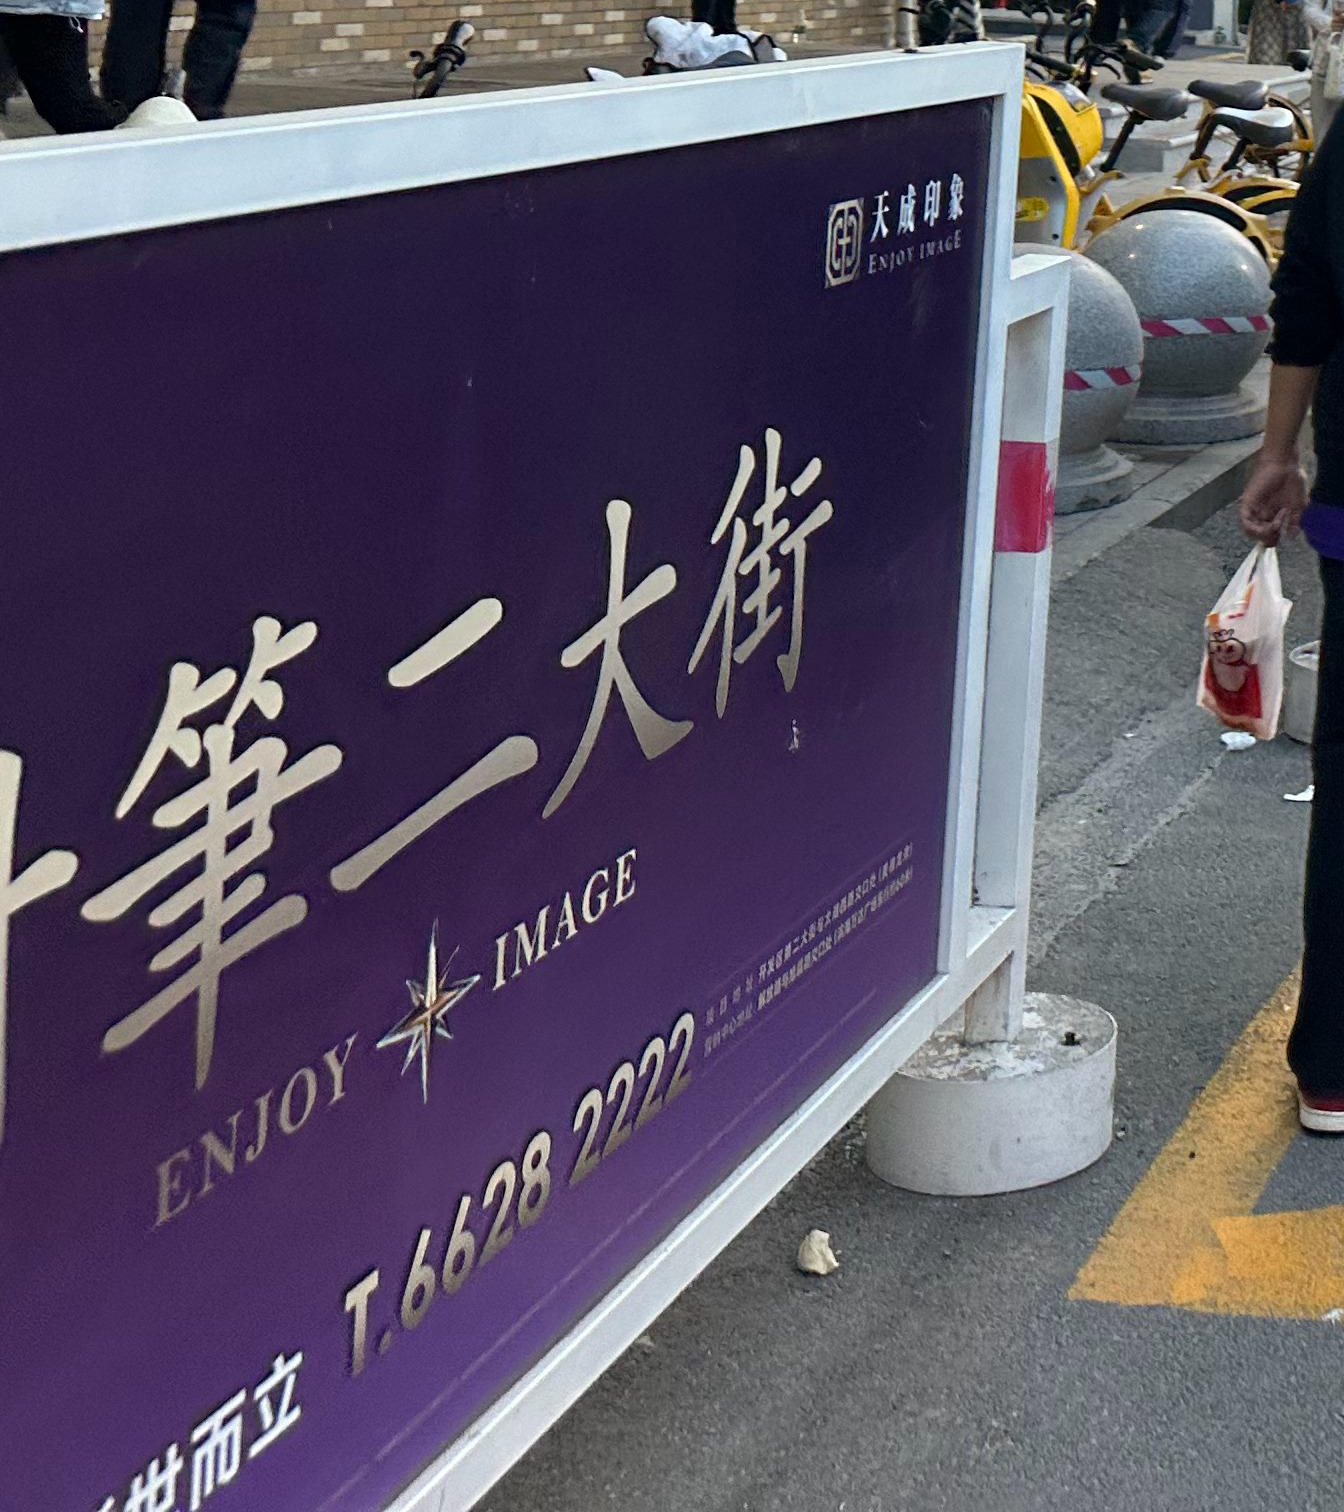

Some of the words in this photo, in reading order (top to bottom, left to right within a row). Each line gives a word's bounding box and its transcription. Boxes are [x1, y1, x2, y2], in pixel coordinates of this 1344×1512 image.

[867, 245, 914, 275] ENJOY
[919, 229, 963, 260] IMAGE
[150, 1031, 362, 1236] ENJOY
[491, 848, 641, 993] IMAGE
[343, 1128, 555, 1378] T.6628
[569, 1010, 696, 1186] 2222
